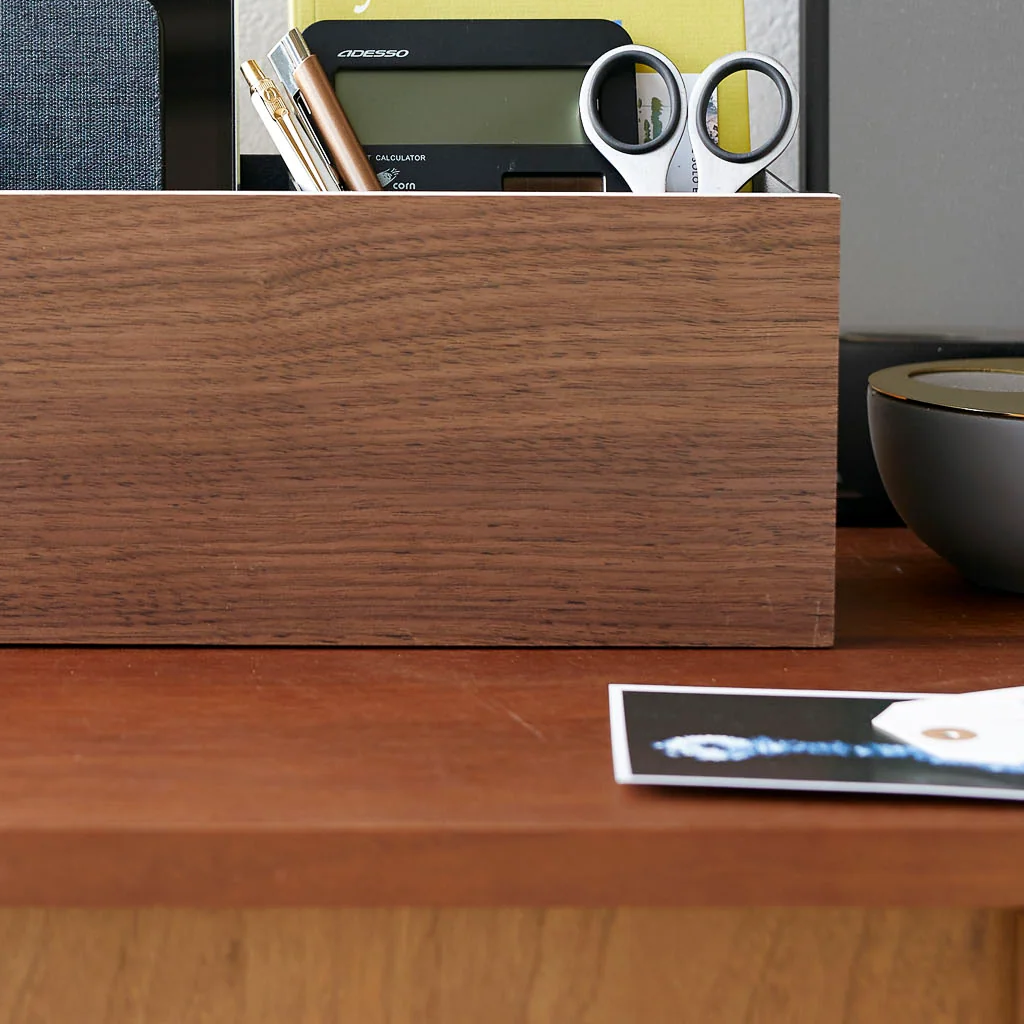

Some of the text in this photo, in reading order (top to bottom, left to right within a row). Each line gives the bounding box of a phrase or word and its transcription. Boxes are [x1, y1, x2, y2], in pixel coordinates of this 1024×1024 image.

[337, 49, 410, 58] ADESSO
[375, 154, 426, 162] CALCULATOR
[392, 182, 417, 190] corn
